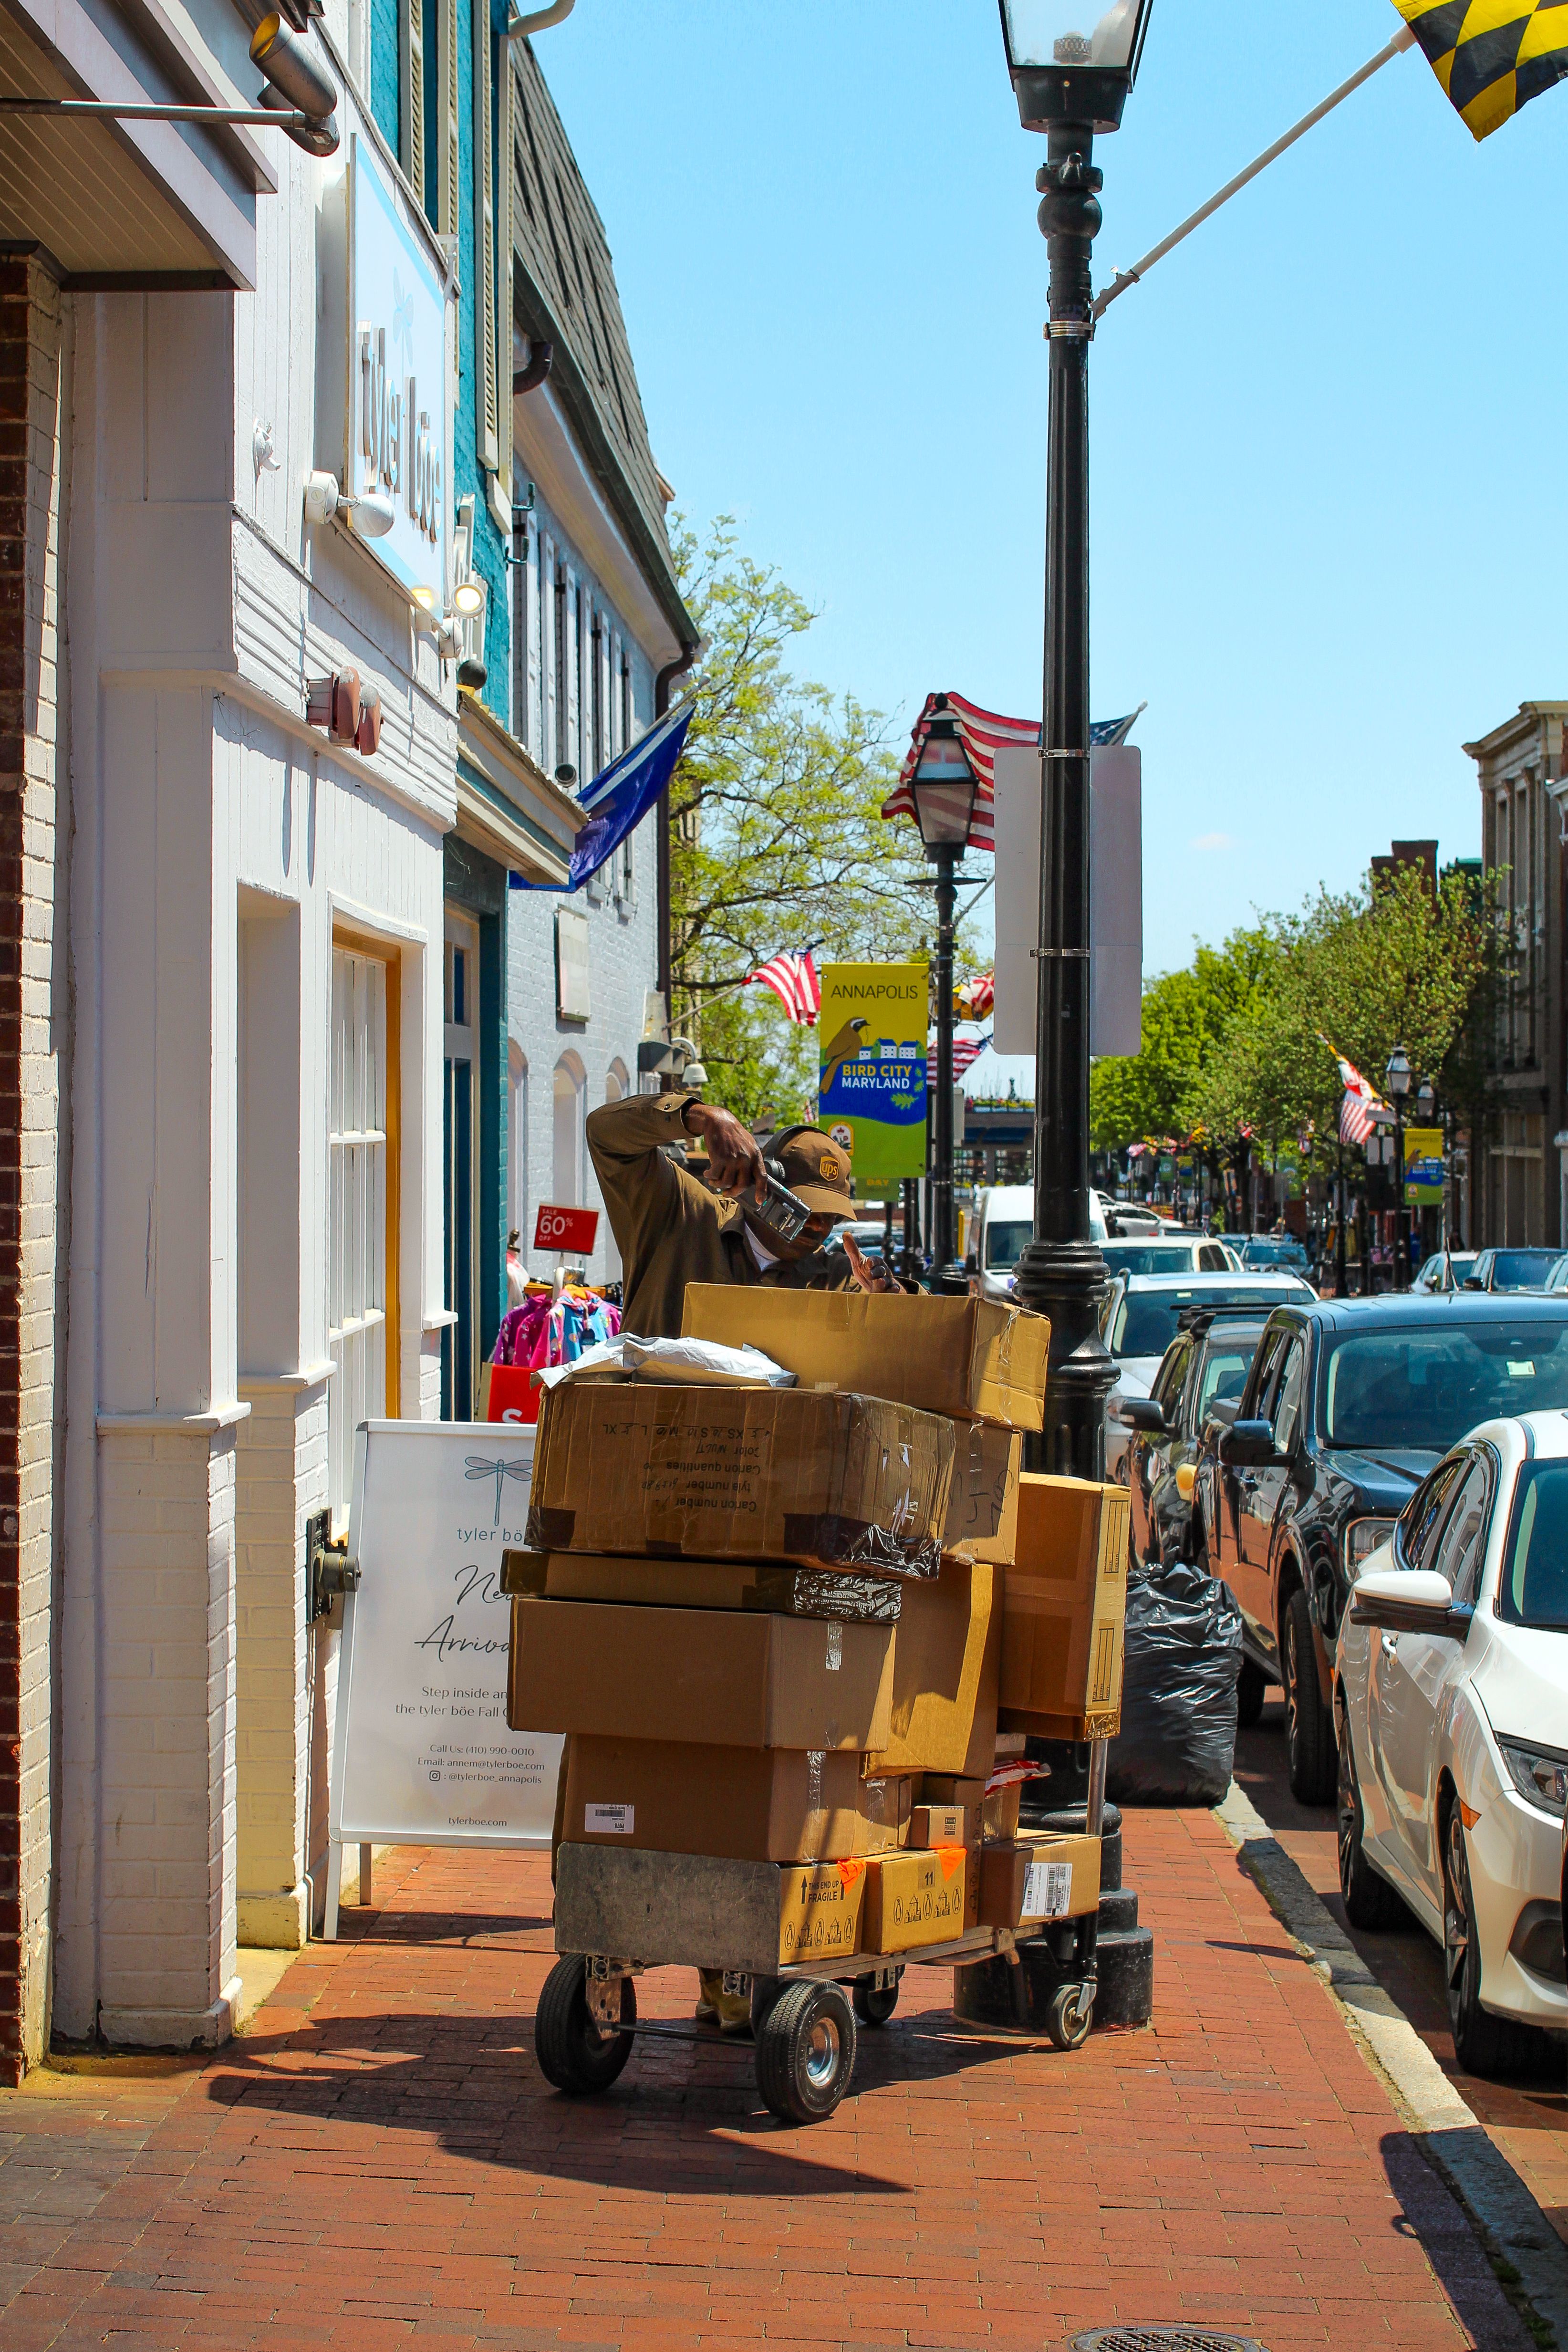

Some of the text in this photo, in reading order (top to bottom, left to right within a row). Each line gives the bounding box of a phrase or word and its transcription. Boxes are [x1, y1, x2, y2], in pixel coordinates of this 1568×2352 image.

[831, 984, 919, 999] ANNAPOLIS
[842, 1064, 912, 1077] BIRD CITY
[841, 1077, 910, 1089] MARYLAND
[821, 1163, 838, 1176] ups
[602, 1424, 617, 1435] XL
[641, 1426, 647, 1436] L
[700, 1428, 708, 1438] S
[728, 1428, 744, 1439] XS
[666, 1461, 722, 1474] quantities
[686, 1480, 729, 1492] number
[675, 1498, 718, 1510] number
[457, 1527, 496, 1543] tyler
[421, 1686, 449, 1700] Step
[453, 1687, 489, 1699] inside
[395, 1704, 416, 1715] the
[419, 1705, 447, 1717] tyler
[451, 1705, 475, 1717] böe
[478, 1707, 499, 1717] Fall
[430, 1744, 535, 1757] Call Us: (410) 990-0010
[418, 1757, 545, 1771] Email: annem@tylerboe.com
[449, 1772, 542, 1784] @tylerboe_annapolis
[448, 1816, 508, 1827] tylerboe.com
[808, 1879, 839, 1890] THIS END UP
[924, 1871, 934, 1886] 11
[808, 1891, 838, 1903] FRAGILE
